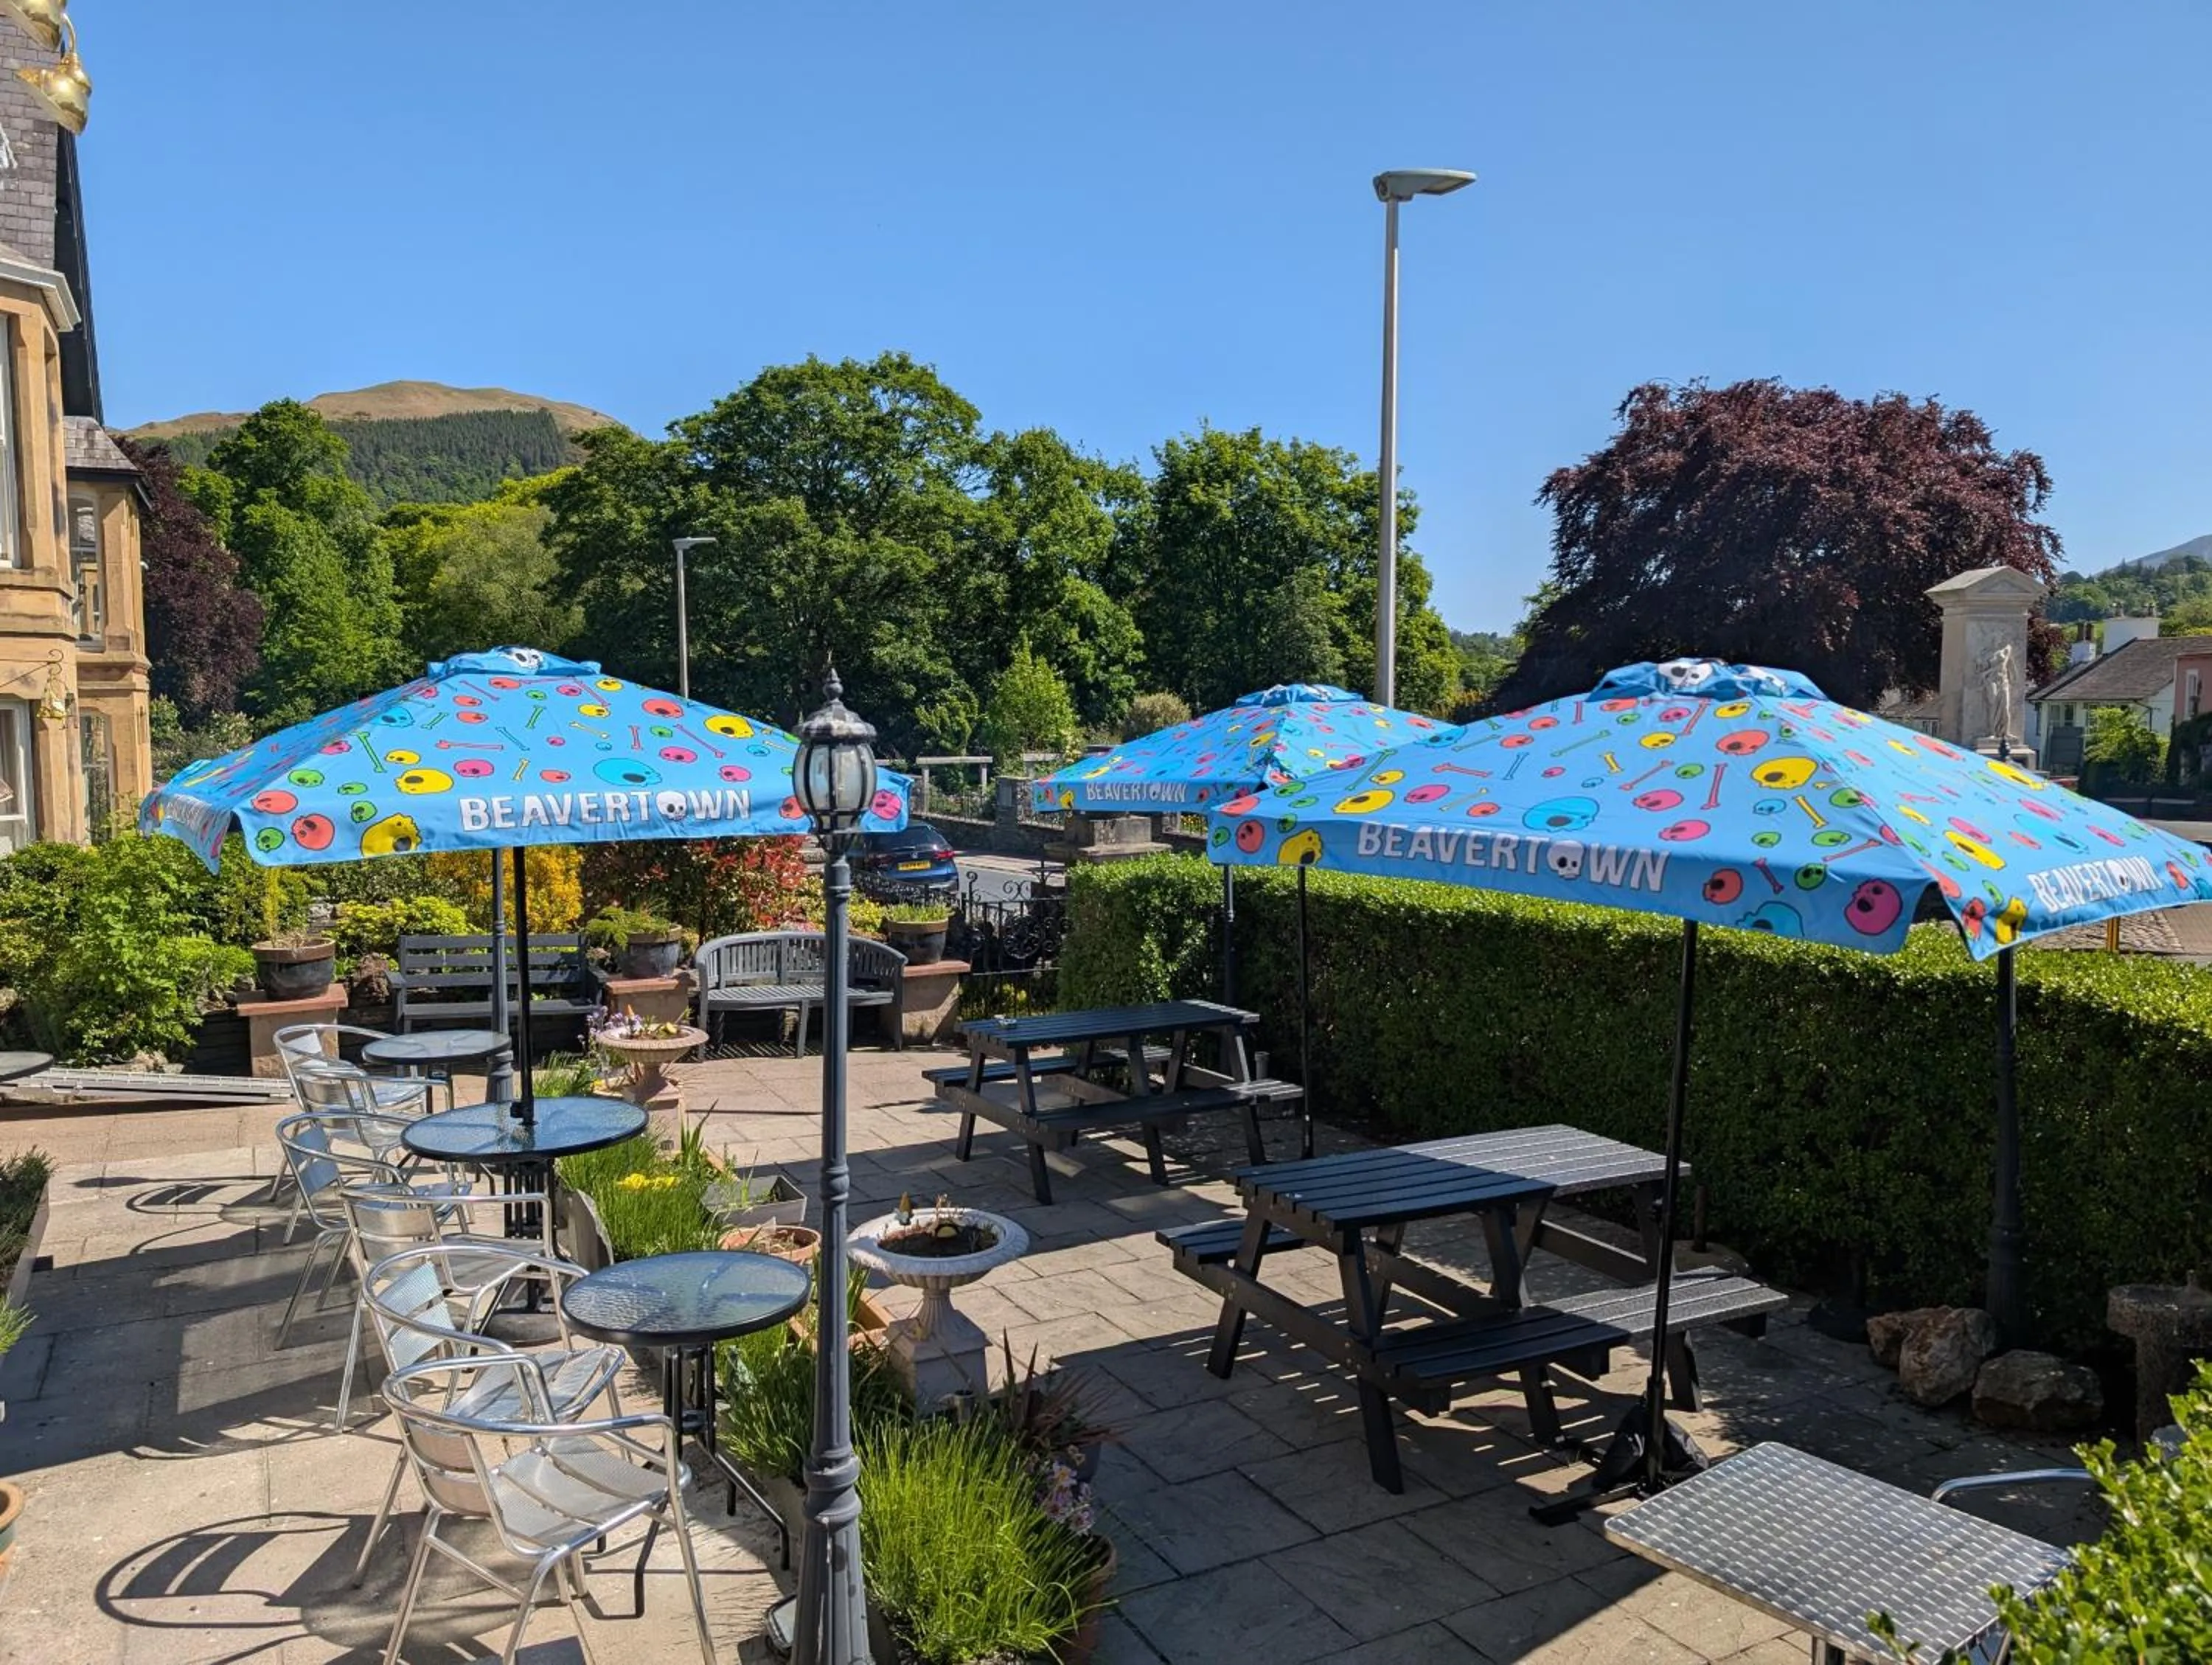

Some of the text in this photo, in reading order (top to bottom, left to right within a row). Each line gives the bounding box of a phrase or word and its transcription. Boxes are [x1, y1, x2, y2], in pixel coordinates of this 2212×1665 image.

[459, 789, 751, 832] BEAVERTOWN
[1086, 782, 1186, 803] BEAVERTOWN
[1357, 821, 1670, 892] BEAVERTOWN
[2026, 855, 2163, 914] BEAVERTOWN
